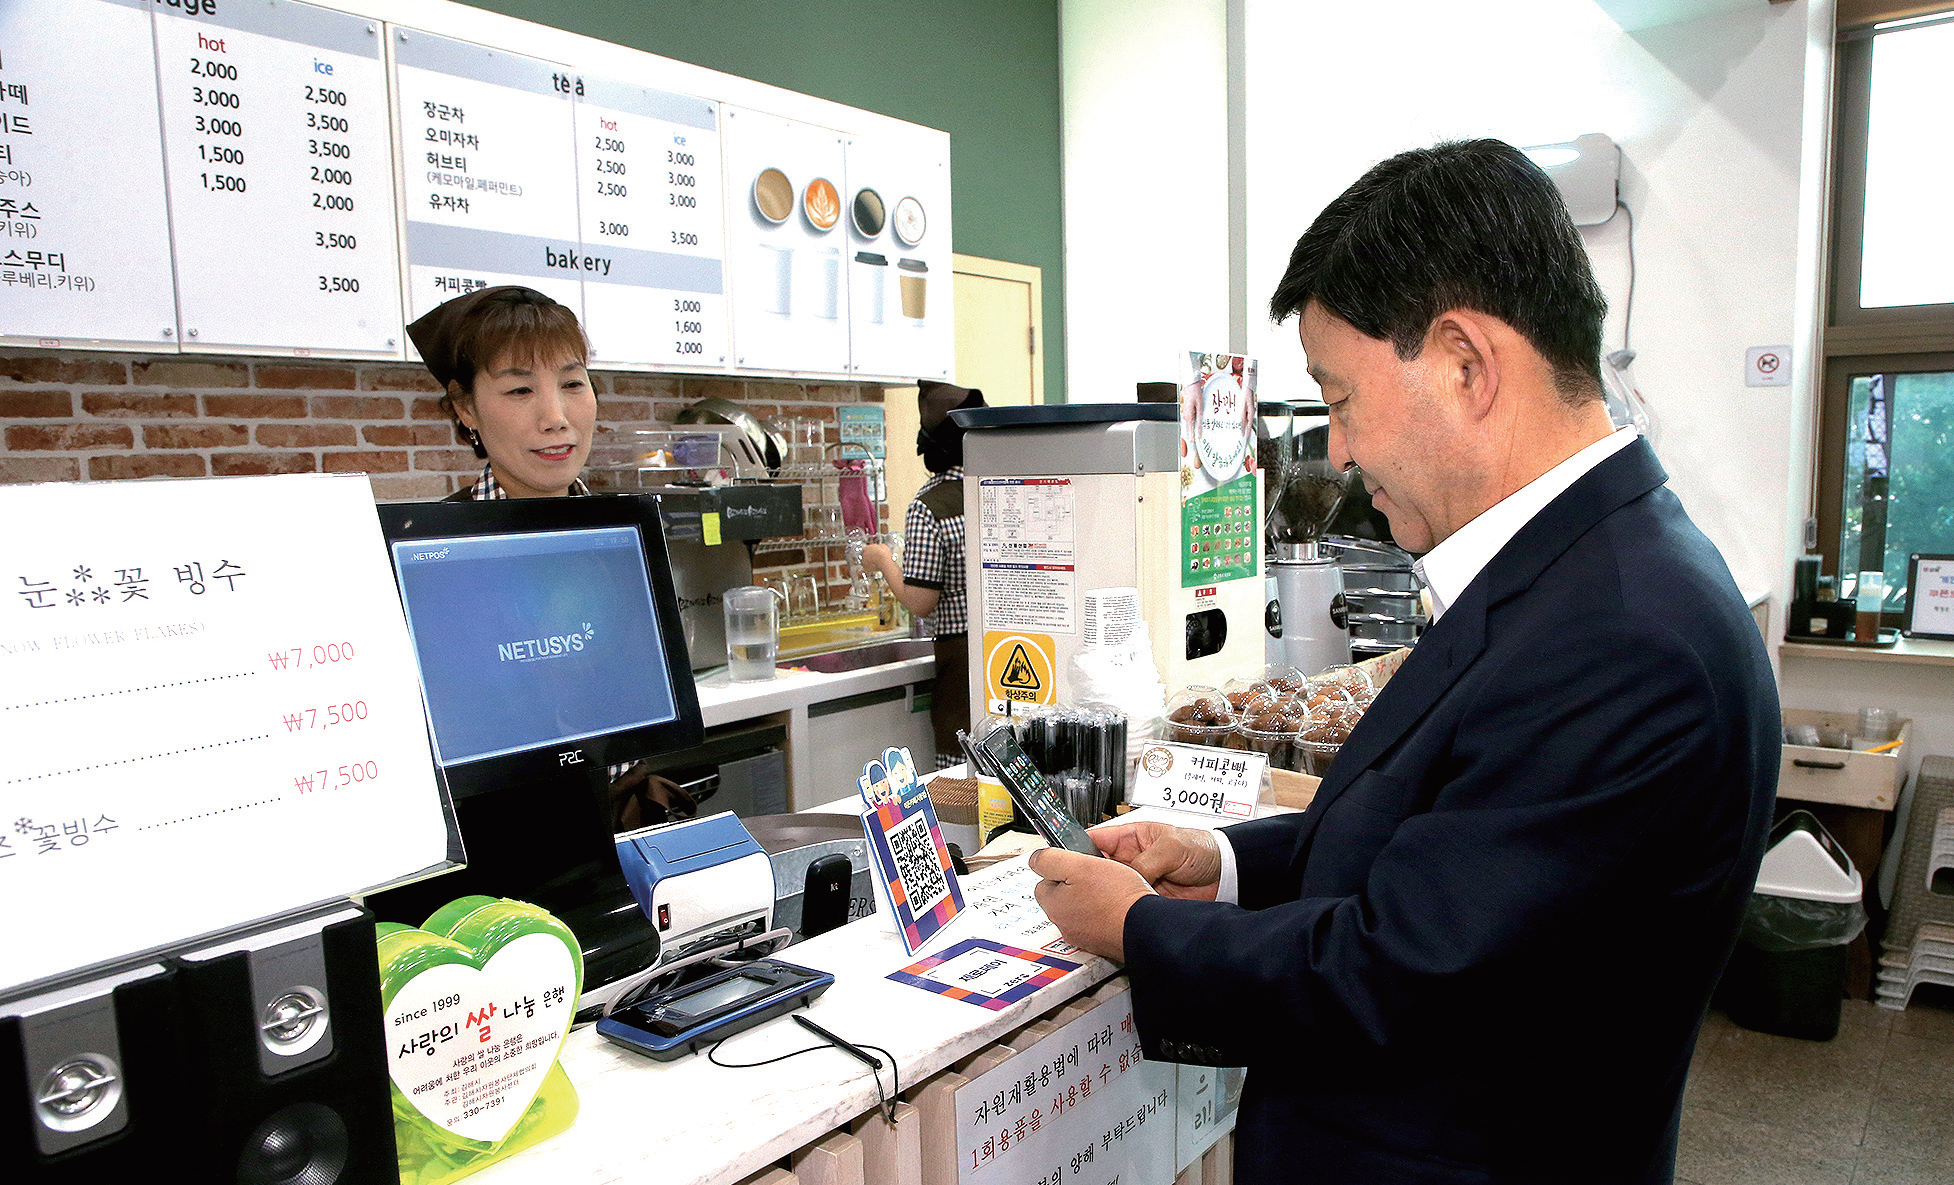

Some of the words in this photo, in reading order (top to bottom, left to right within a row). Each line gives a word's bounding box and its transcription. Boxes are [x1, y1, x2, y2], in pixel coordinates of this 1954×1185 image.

[198, 32, 226, 54] hot
[190, 58, 238, 81] 2,000
[313, 57, 334, 76] ice
[552, 72, 586, 97] tea
[192, 87, 240, 109] 3,000
[304, 86, 347, 106] 2,500
[423, 100, 465, 124] 장군차
[195, 116, 242, 137] 3,000
[306, 113, 348, 133] 3,500
[600, 117, 618, 132] hot
[425, 127, 479, 151] 오미자차
[595, 137, 626, 154] 2,500
[673, 132, 686, 147] ice
[198, 144, 244, 165] 1,500
[308, 140, 350, 159] 3,500
[667, 151, 694, 167] 3,000
[426, 152, 467, 173] 허브티
[596, 160, 627, 175] 2,500
[200, 173, 246, 193] 1,500
[310, 166, 352, 185] 2,000
[668, 172, 695, 188] 3,000
[597, 182, 628, 197] 2,500
[312, 193, 354, 212] 2,000
[429, 193, 470, 214] 유자차
[669, 194, 697, 209] 3,000
[599, 222, 629, 237] 3,000
[671, 231, 698, 246] 3,500
[315, 232, 357, 250] 3,500
[545, 246, 611, 276] bakery
[318, 276, 360, 294] 3,500
[674, 300, 701, 314] 3,000
[675, 320, 702, 334] 1,600
[675, 341, 703, 355] 2,000
[172, 560, 246, 595] 빙수
[268, 641, 355, 671] ₩7,000
[498, 633, 584, 662] NETUSYS
[282, 700, 368, 732] ₩7,500
[294, 760, 378, 794] ₩7,500
[1191, 756, 1248, 778] 커피콩빵
[1163, 787, 1225, 815] 3,000원
[830, 882, 839, 892] kt
[394, 1009, 428, 1027] since
[432, 993, 461, 1012] 1999
[398, 1022, 459, 1059] 사랑의
[466, 1002, 497, 1043] 쌀
[503, 995, 536, 1019] 나눔
[542, 986, 565, 1008] 은행
[974, 1044, 1080, 1126] 자원재활용법에
[1087, 1025, 1114, 1055] 따라
[971, 1107, 1043, 1170] 1회용품을
[1050, 1074, 1093, 1115] 사용할
[1099, 1063, 1112, 1084] 수
[1070, 1142, 1094, 1175] 양해
[1101, 1088, 1168, 1152] 부탁드립니다
